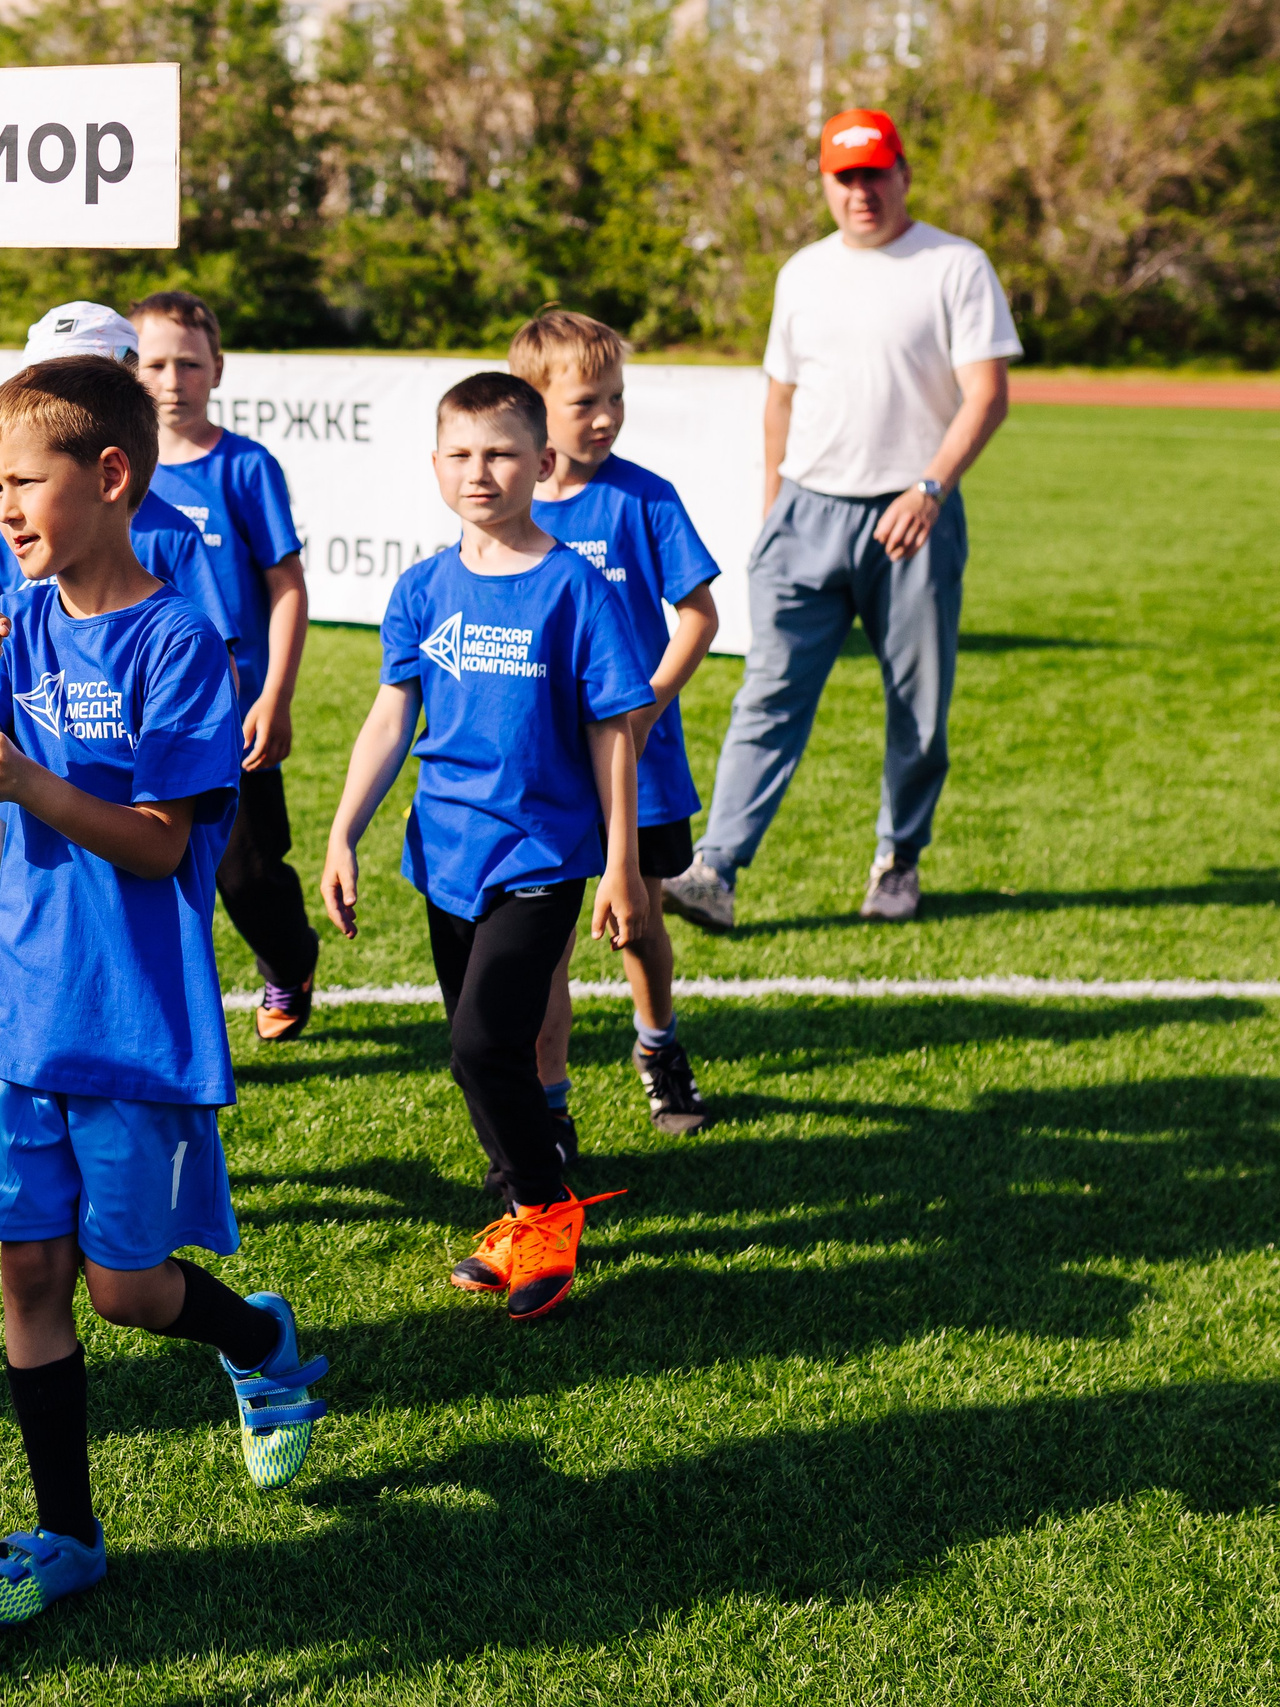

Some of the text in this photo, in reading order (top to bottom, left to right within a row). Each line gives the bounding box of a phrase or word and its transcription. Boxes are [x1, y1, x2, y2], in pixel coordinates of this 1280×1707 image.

[464, 623, 533, 645] РУССКАЯ
[462, 639, 529, 660] МЕДНАЯ
[461, 656, 547, 678] КОМПАНИЯ
